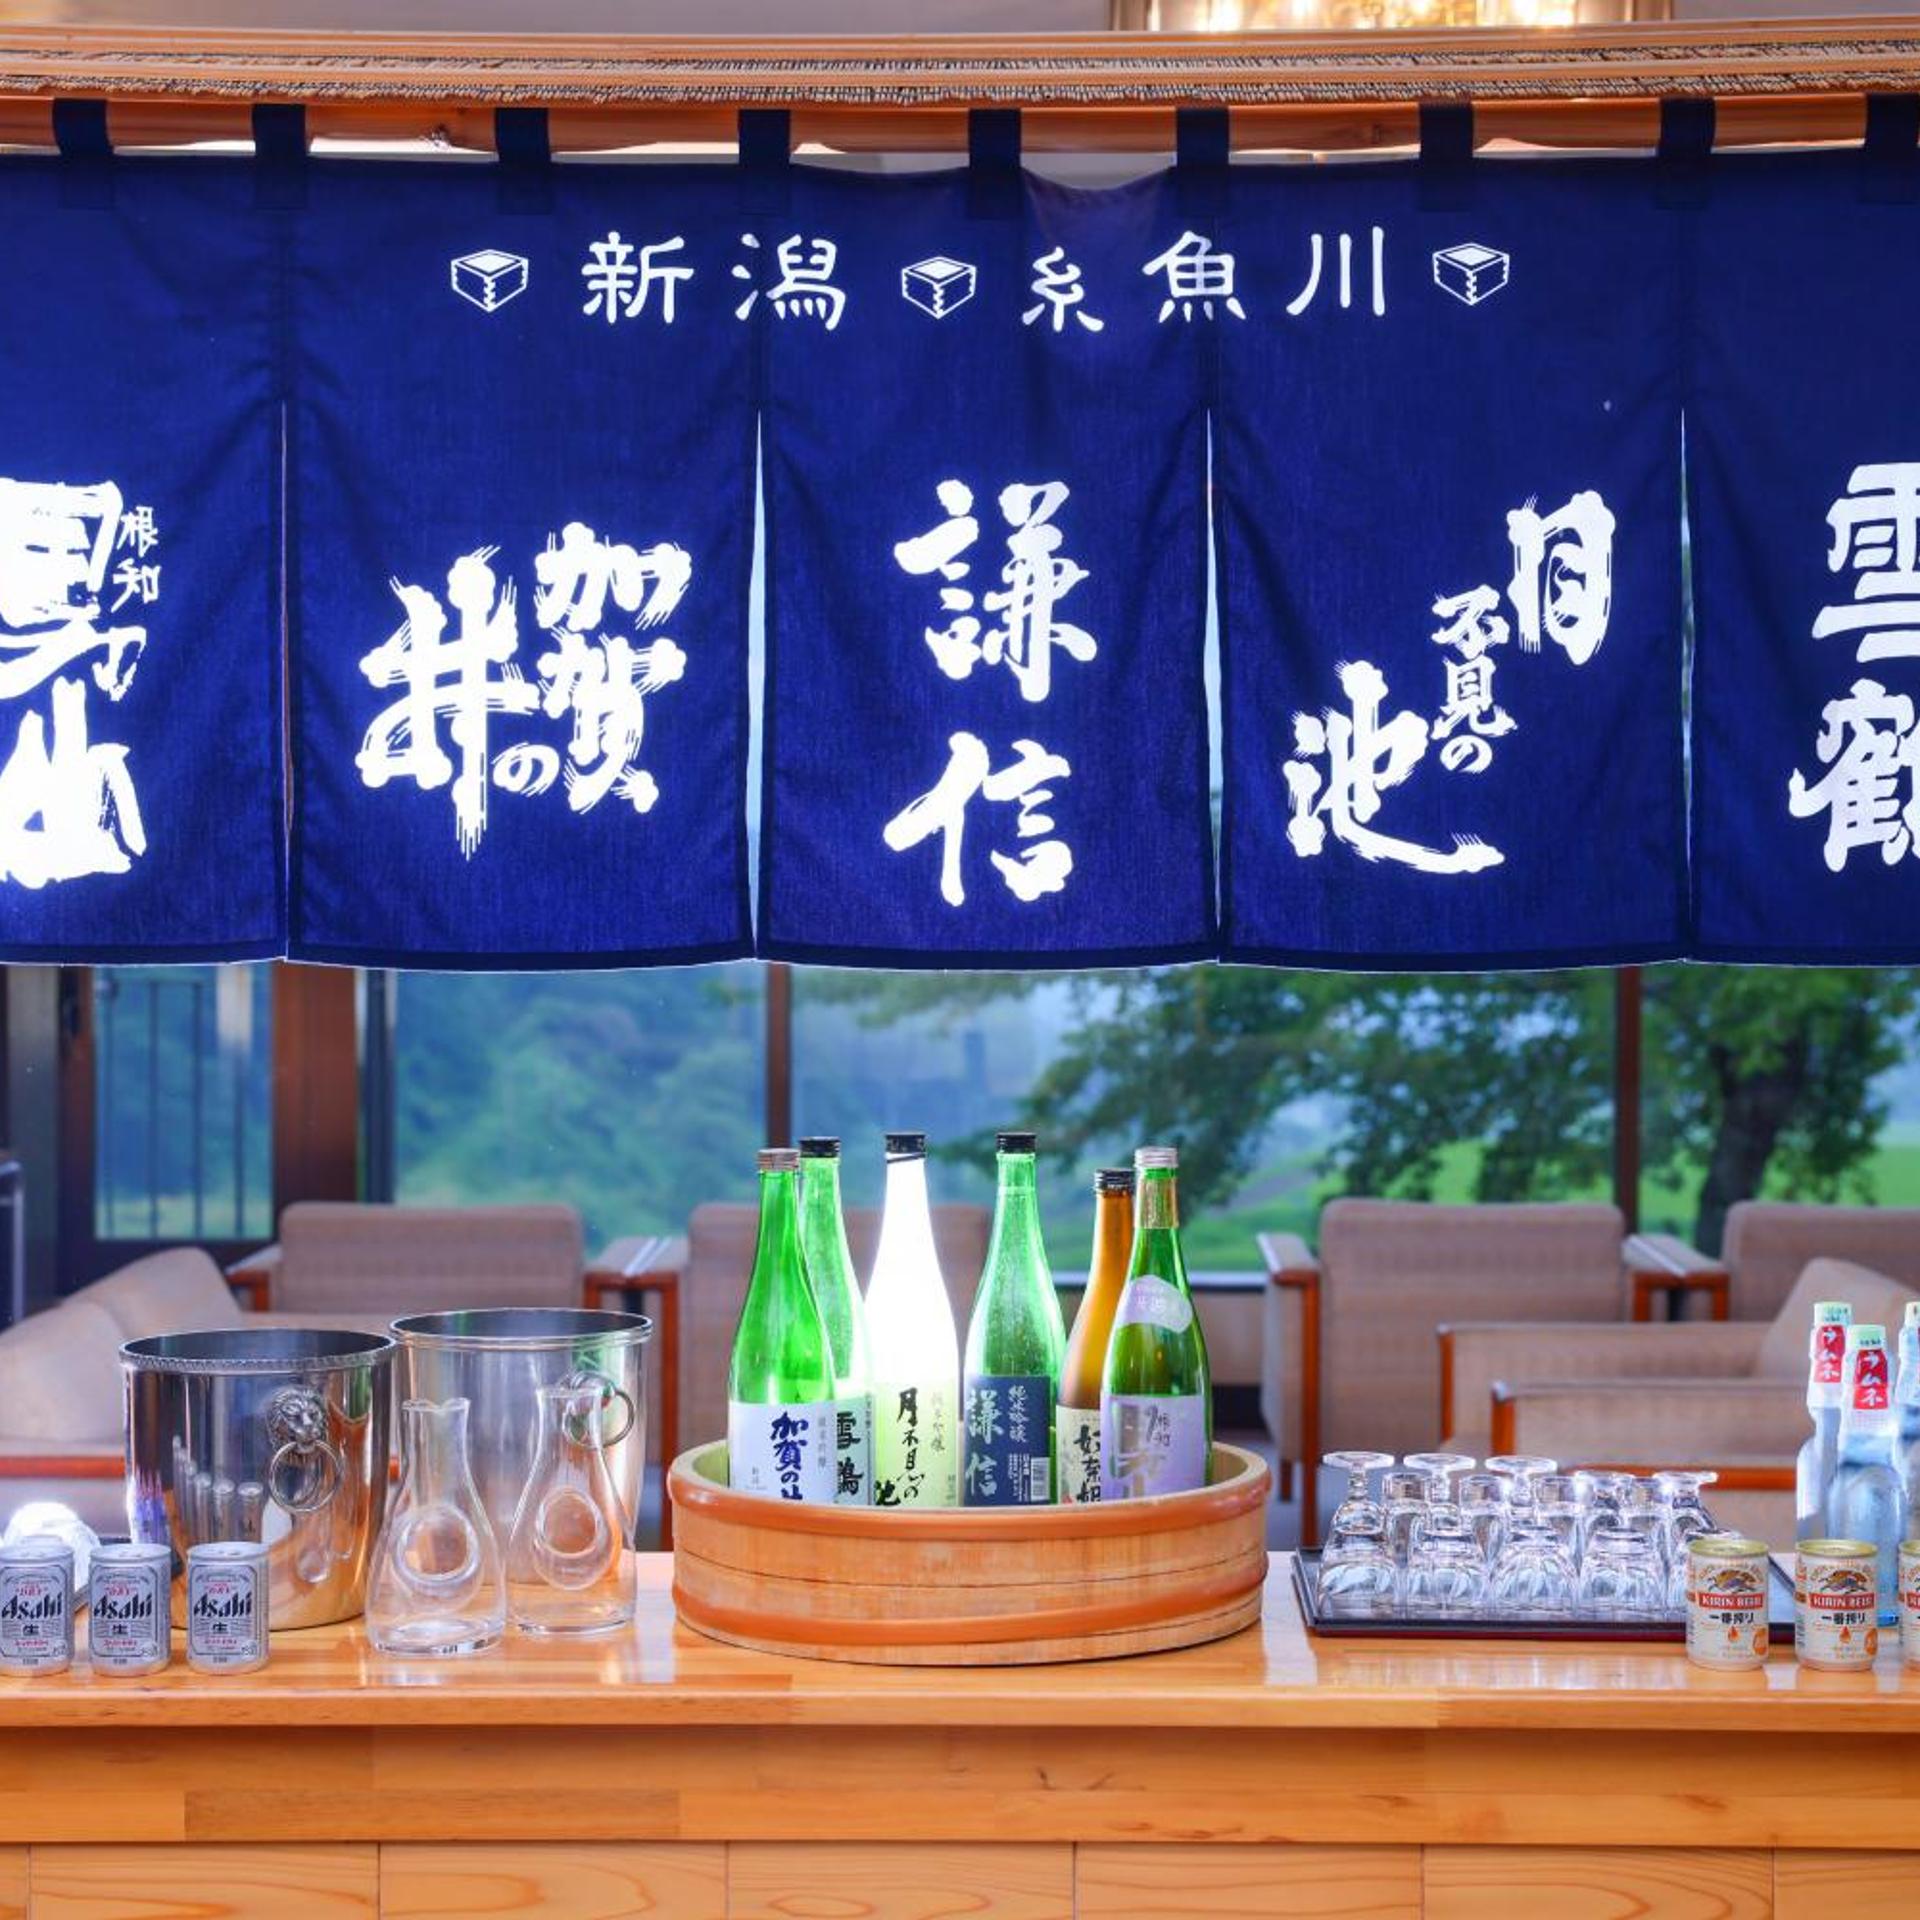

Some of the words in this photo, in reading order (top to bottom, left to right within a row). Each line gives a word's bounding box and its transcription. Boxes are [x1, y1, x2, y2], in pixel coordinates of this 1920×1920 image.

[582, 231, 845, 332] 新潟
[1021, 227, 1385, 335] 糸魚川
[111, 505, 162, 614] 根知
[883, 480, 1097, 907] 謙信
[1860, 1351, 1884, 1407] ラムネ
[2, 1592, 62, 1619] Asahi
[94, 1592, 152, 1619] Asahi
[194, 1591, 252, 1617] Asahi
[1702, 1594, 1735, 1608] KIRIN
[1814, 1595, 1846, 1608] KIRIN
